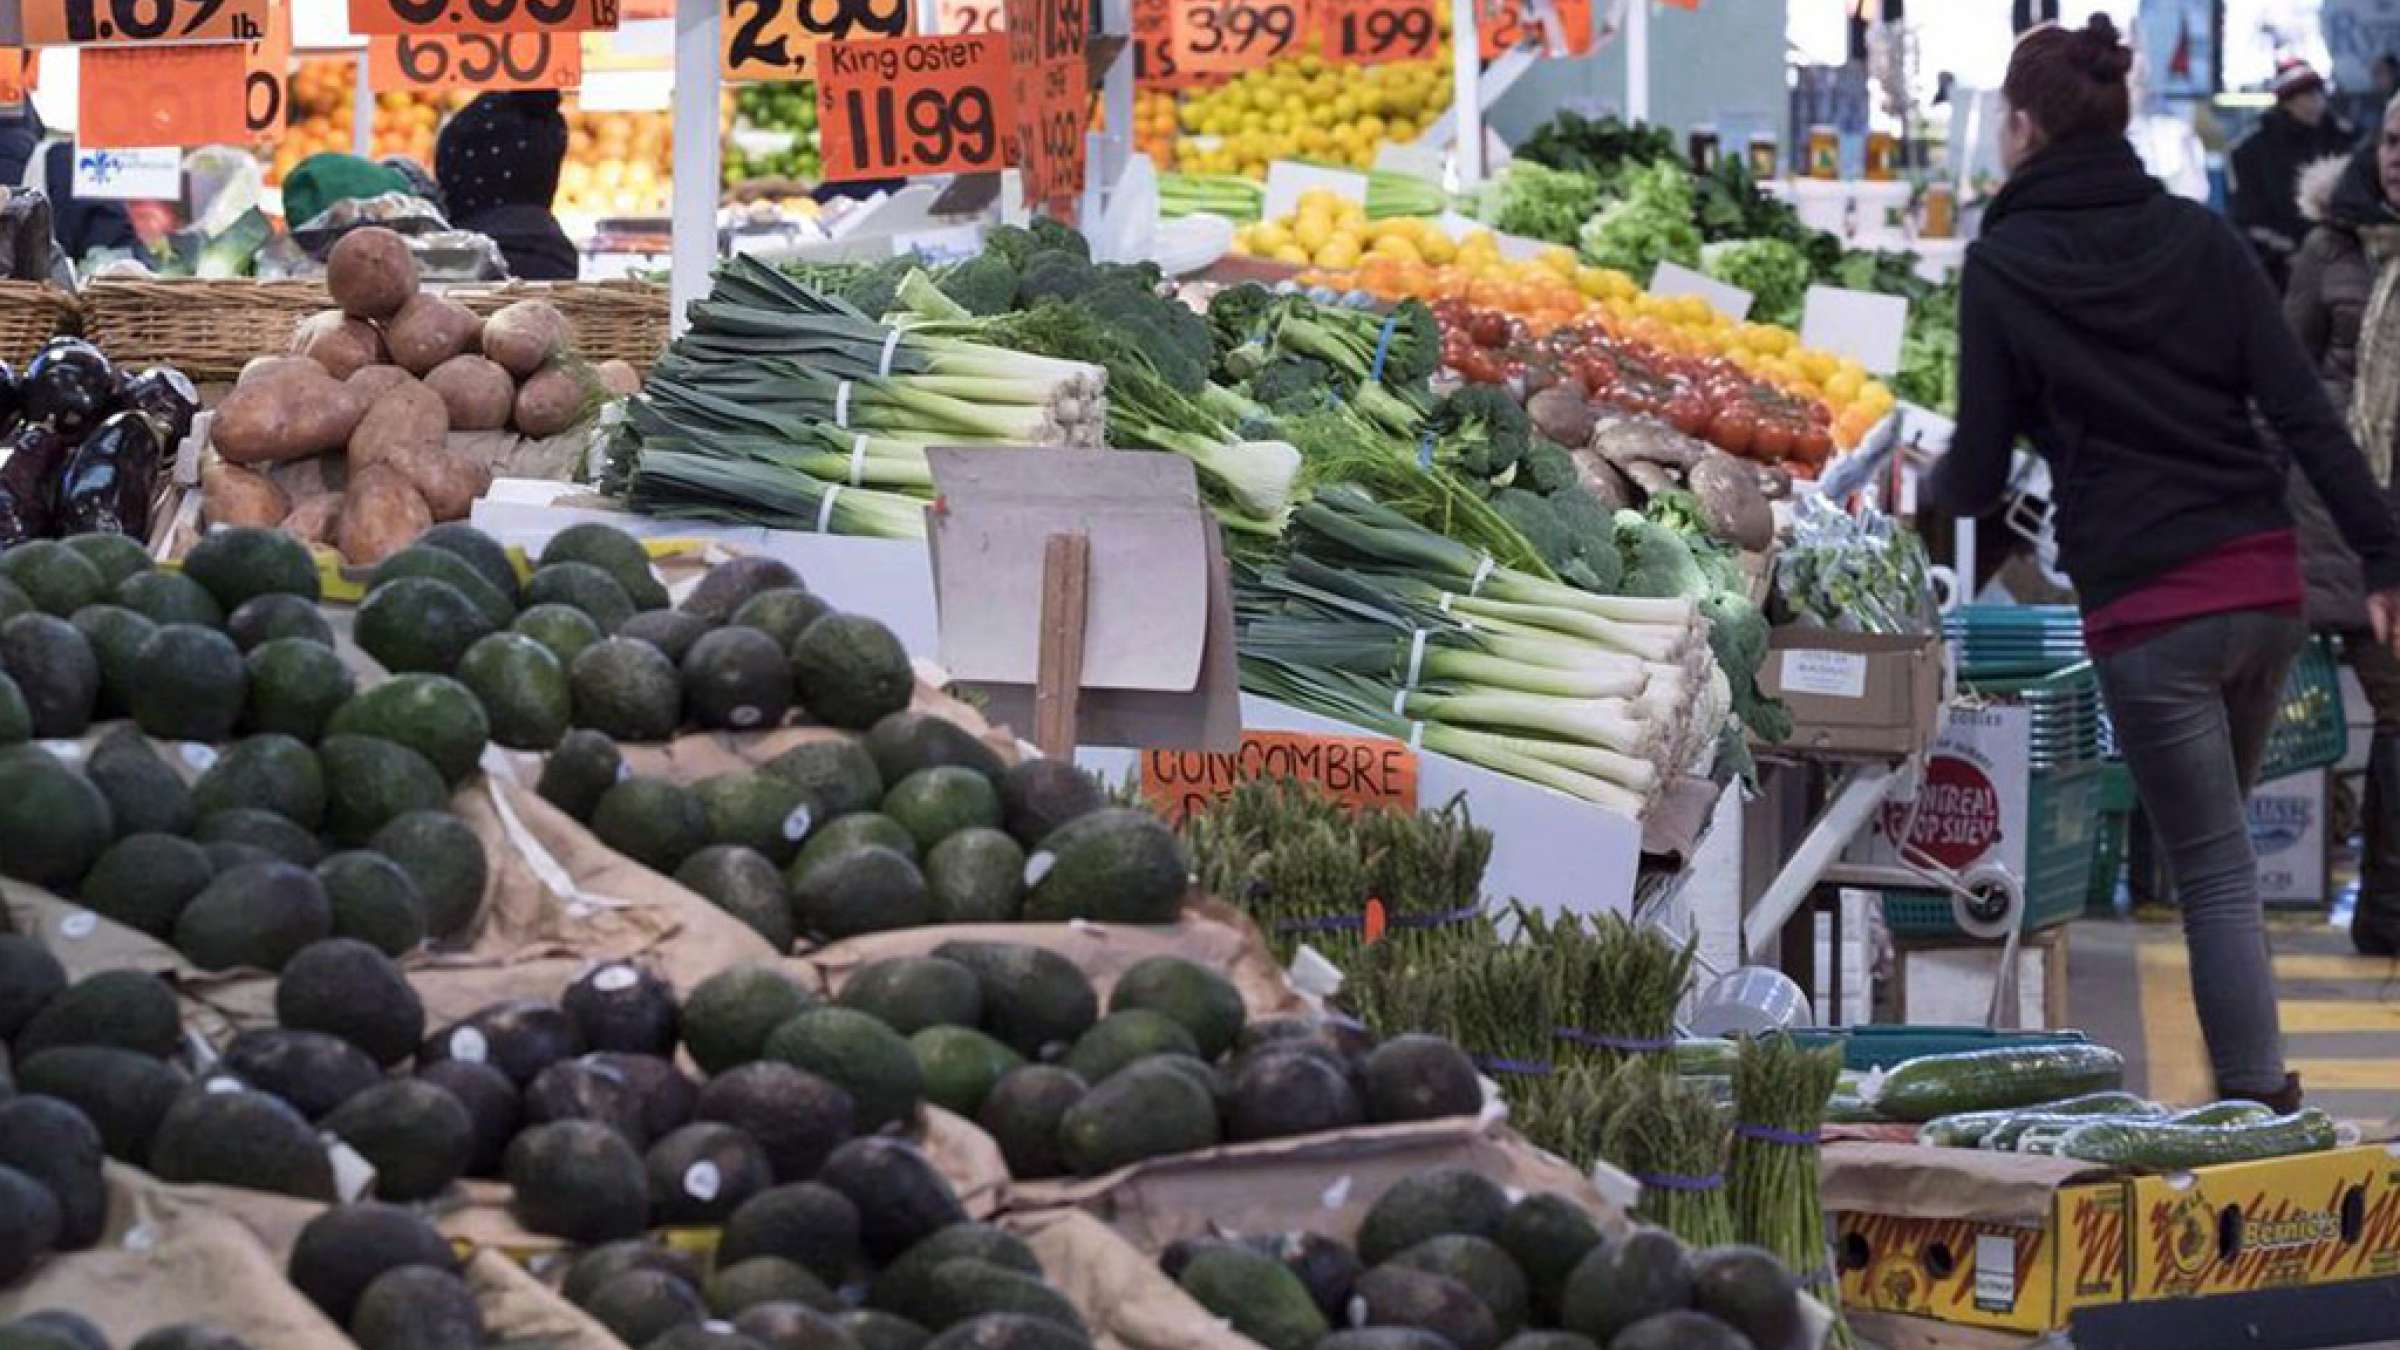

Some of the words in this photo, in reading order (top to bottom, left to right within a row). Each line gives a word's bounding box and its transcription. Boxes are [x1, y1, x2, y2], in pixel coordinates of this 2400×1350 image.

[1186, 4, 1296, 57] 3.99
[397, 31, 552, 84] 6.50
[831, 44, 899, 81] King
[904, 40, 985, 72] Oster
[846, 86, 996, 169] 11.99
